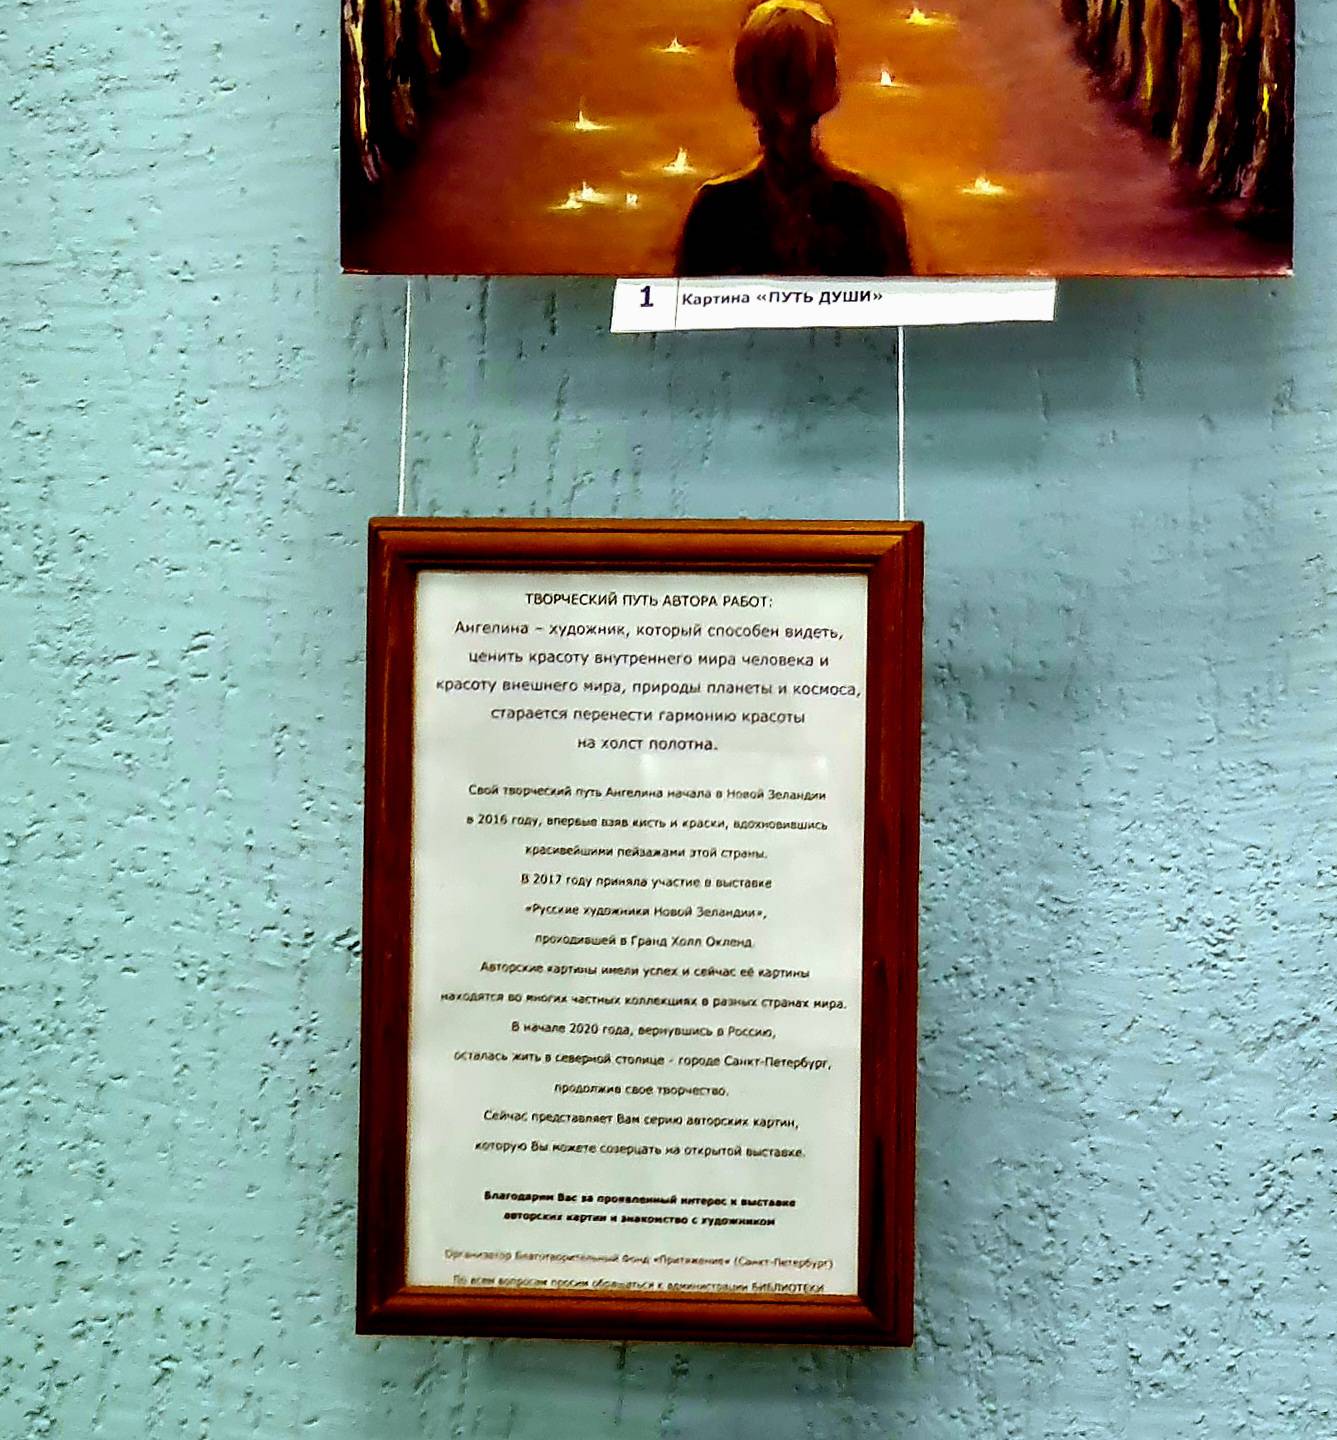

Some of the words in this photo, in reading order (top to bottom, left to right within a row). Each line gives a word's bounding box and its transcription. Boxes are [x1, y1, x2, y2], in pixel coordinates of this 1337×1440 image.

[640, 285, 654, 307] 1
[681, 292, 751, 308] Картина
[526, 591, 617, 607] ТВОРЧЕСКИЙ
[623, 594, 658, 607] ПУТЬ
[662, 594, 718, 608] АВТОРА
[723, 595, 772, 608] РАБОТ:
[455, 620, 529, 635] Ангелина
[549, 624, 630, 640] художник,
[637, 623, 702, 639] который
[707, 623, 779, 639] способен
[785, 627, 843, 641] видеть,
[469, 650, 523, 664] ценить
[529, 651, 589, 667] красоту
[594, 653, 693, 668] внутреннего
[698, 654, 736, 669] мира
[742, 655, 814, 667] человека
[820, 656, 829, 668] и
[436, 679, 497, 693] красоту
[502, 680, 578, 693] внешнего
[583, 681, 626, 695] мира,
[632, 681, 701, 697] природы
[707, 682, 773, 696] планеты
[778, 684, 787, 695] и
[793, 683, 861, 698] космоса,
[491, 707, 568, 722] старается
[573, 709, 653, 723] перенести
[659, 709, 737, 725] гармонию
[742, 711, 805, 726] красоты
[578, 738, 596, 750] на
[601, 738, 644, 750] холст
[649, 738, 718, 751] полотна.
